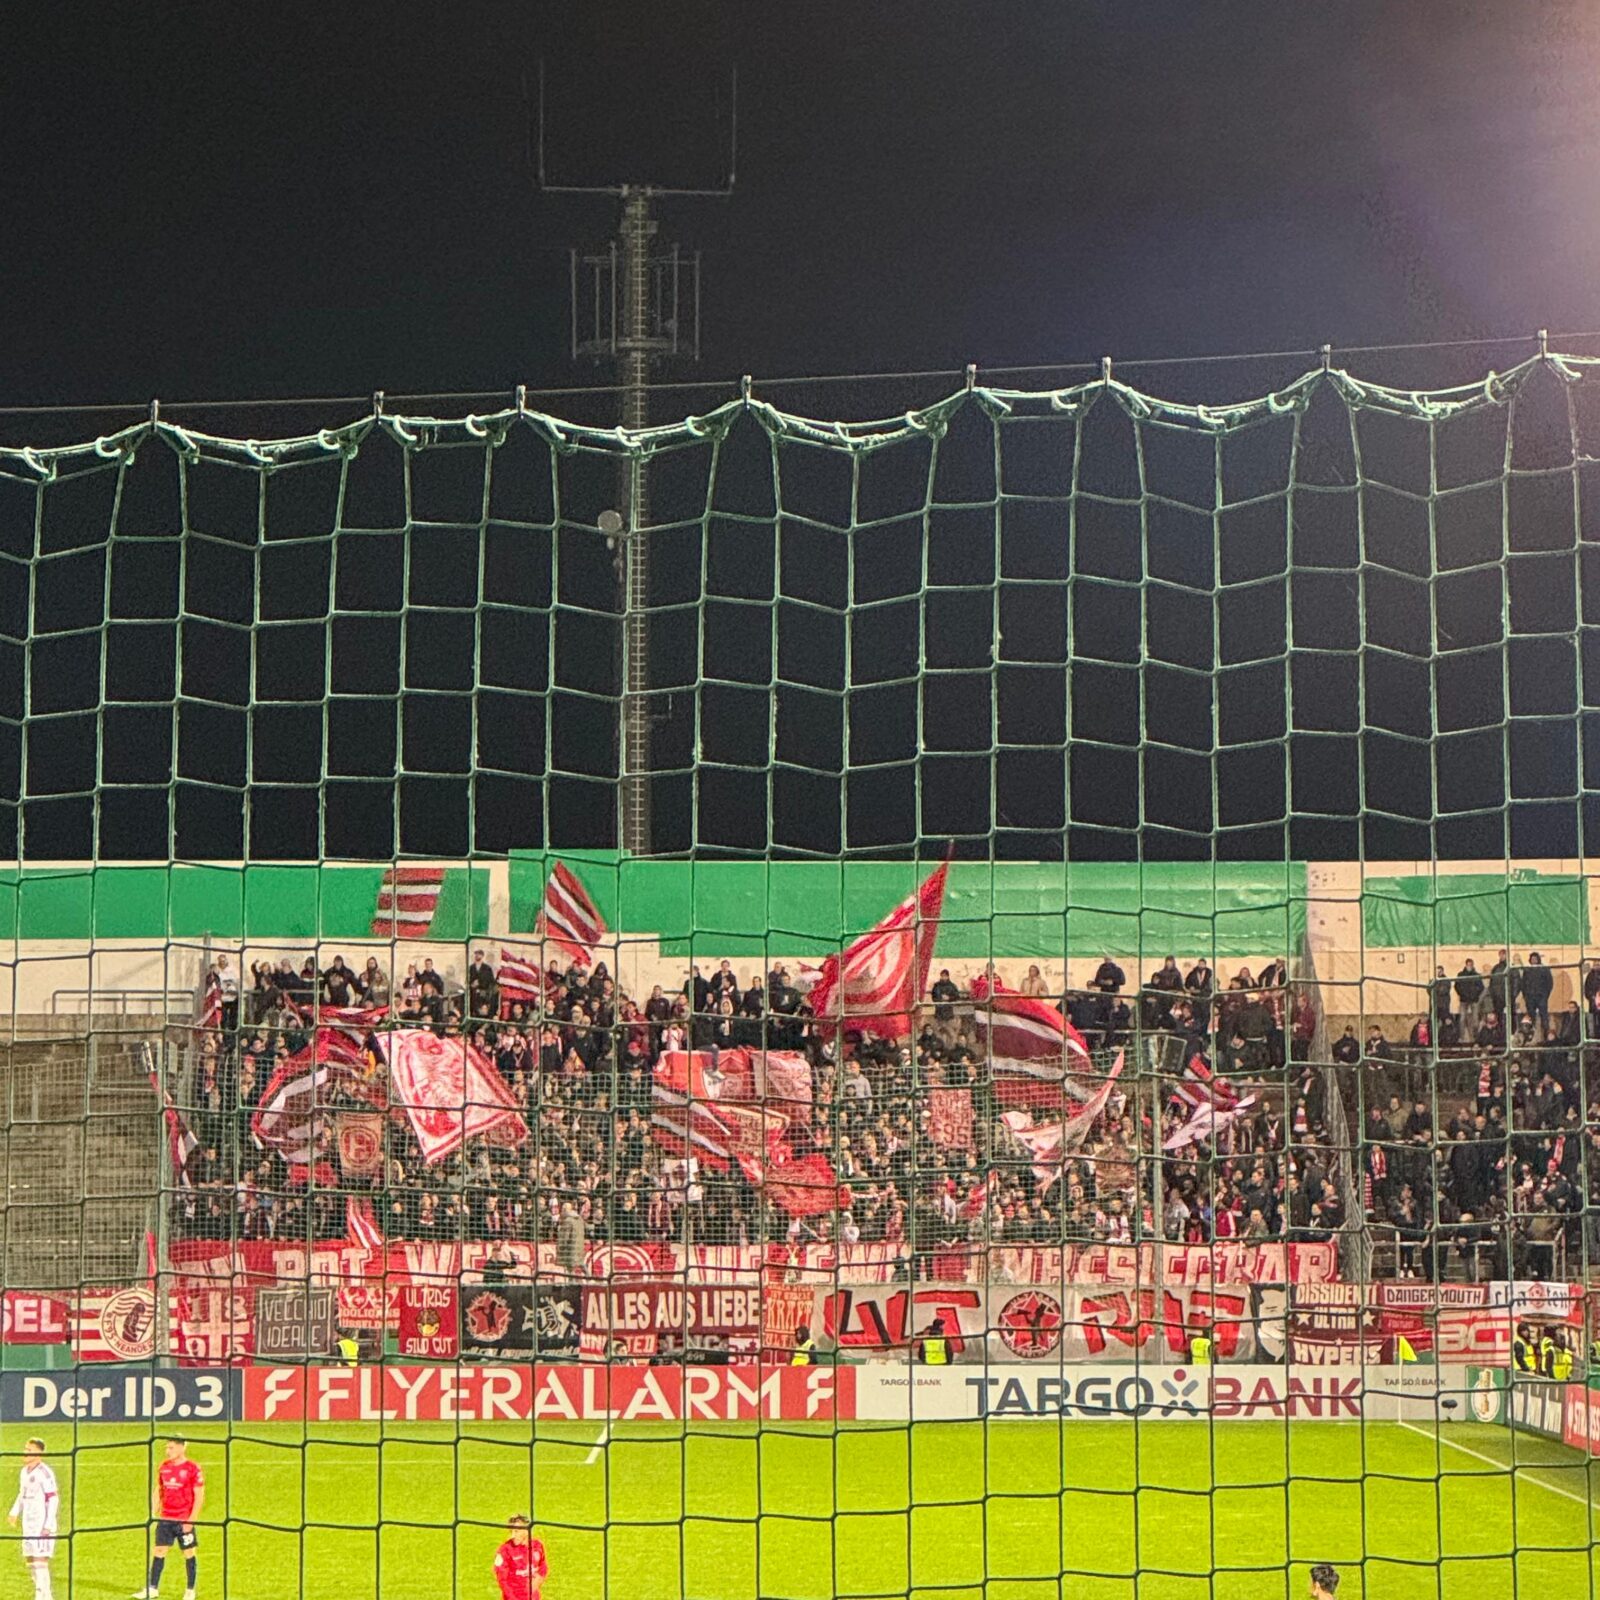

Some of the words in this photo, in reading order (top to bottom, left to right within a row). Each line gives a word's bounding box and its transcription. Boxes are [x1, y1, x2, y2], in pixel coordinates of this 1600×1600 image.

[404, 1243, 569, 1284] WESS
[585, 1291, 651, 1330] ALLES
[655, 1290, 697, 1329] AUS
[701, 1290, 761, 1327] LIEBE
[1295, 1283, 1378, 1305] DISSIDENTI
[266, 1325, 321, 1349] IDEALE
[22, 1377, 112, 1418] Der
[124, 1375, 224, 1419] ID.3
[318, 1368, 782, 1420] FLYERALARM
[964, 1377, 1155, 1417] TARGO
[1210, 1376, 1363, 1417] BANK
